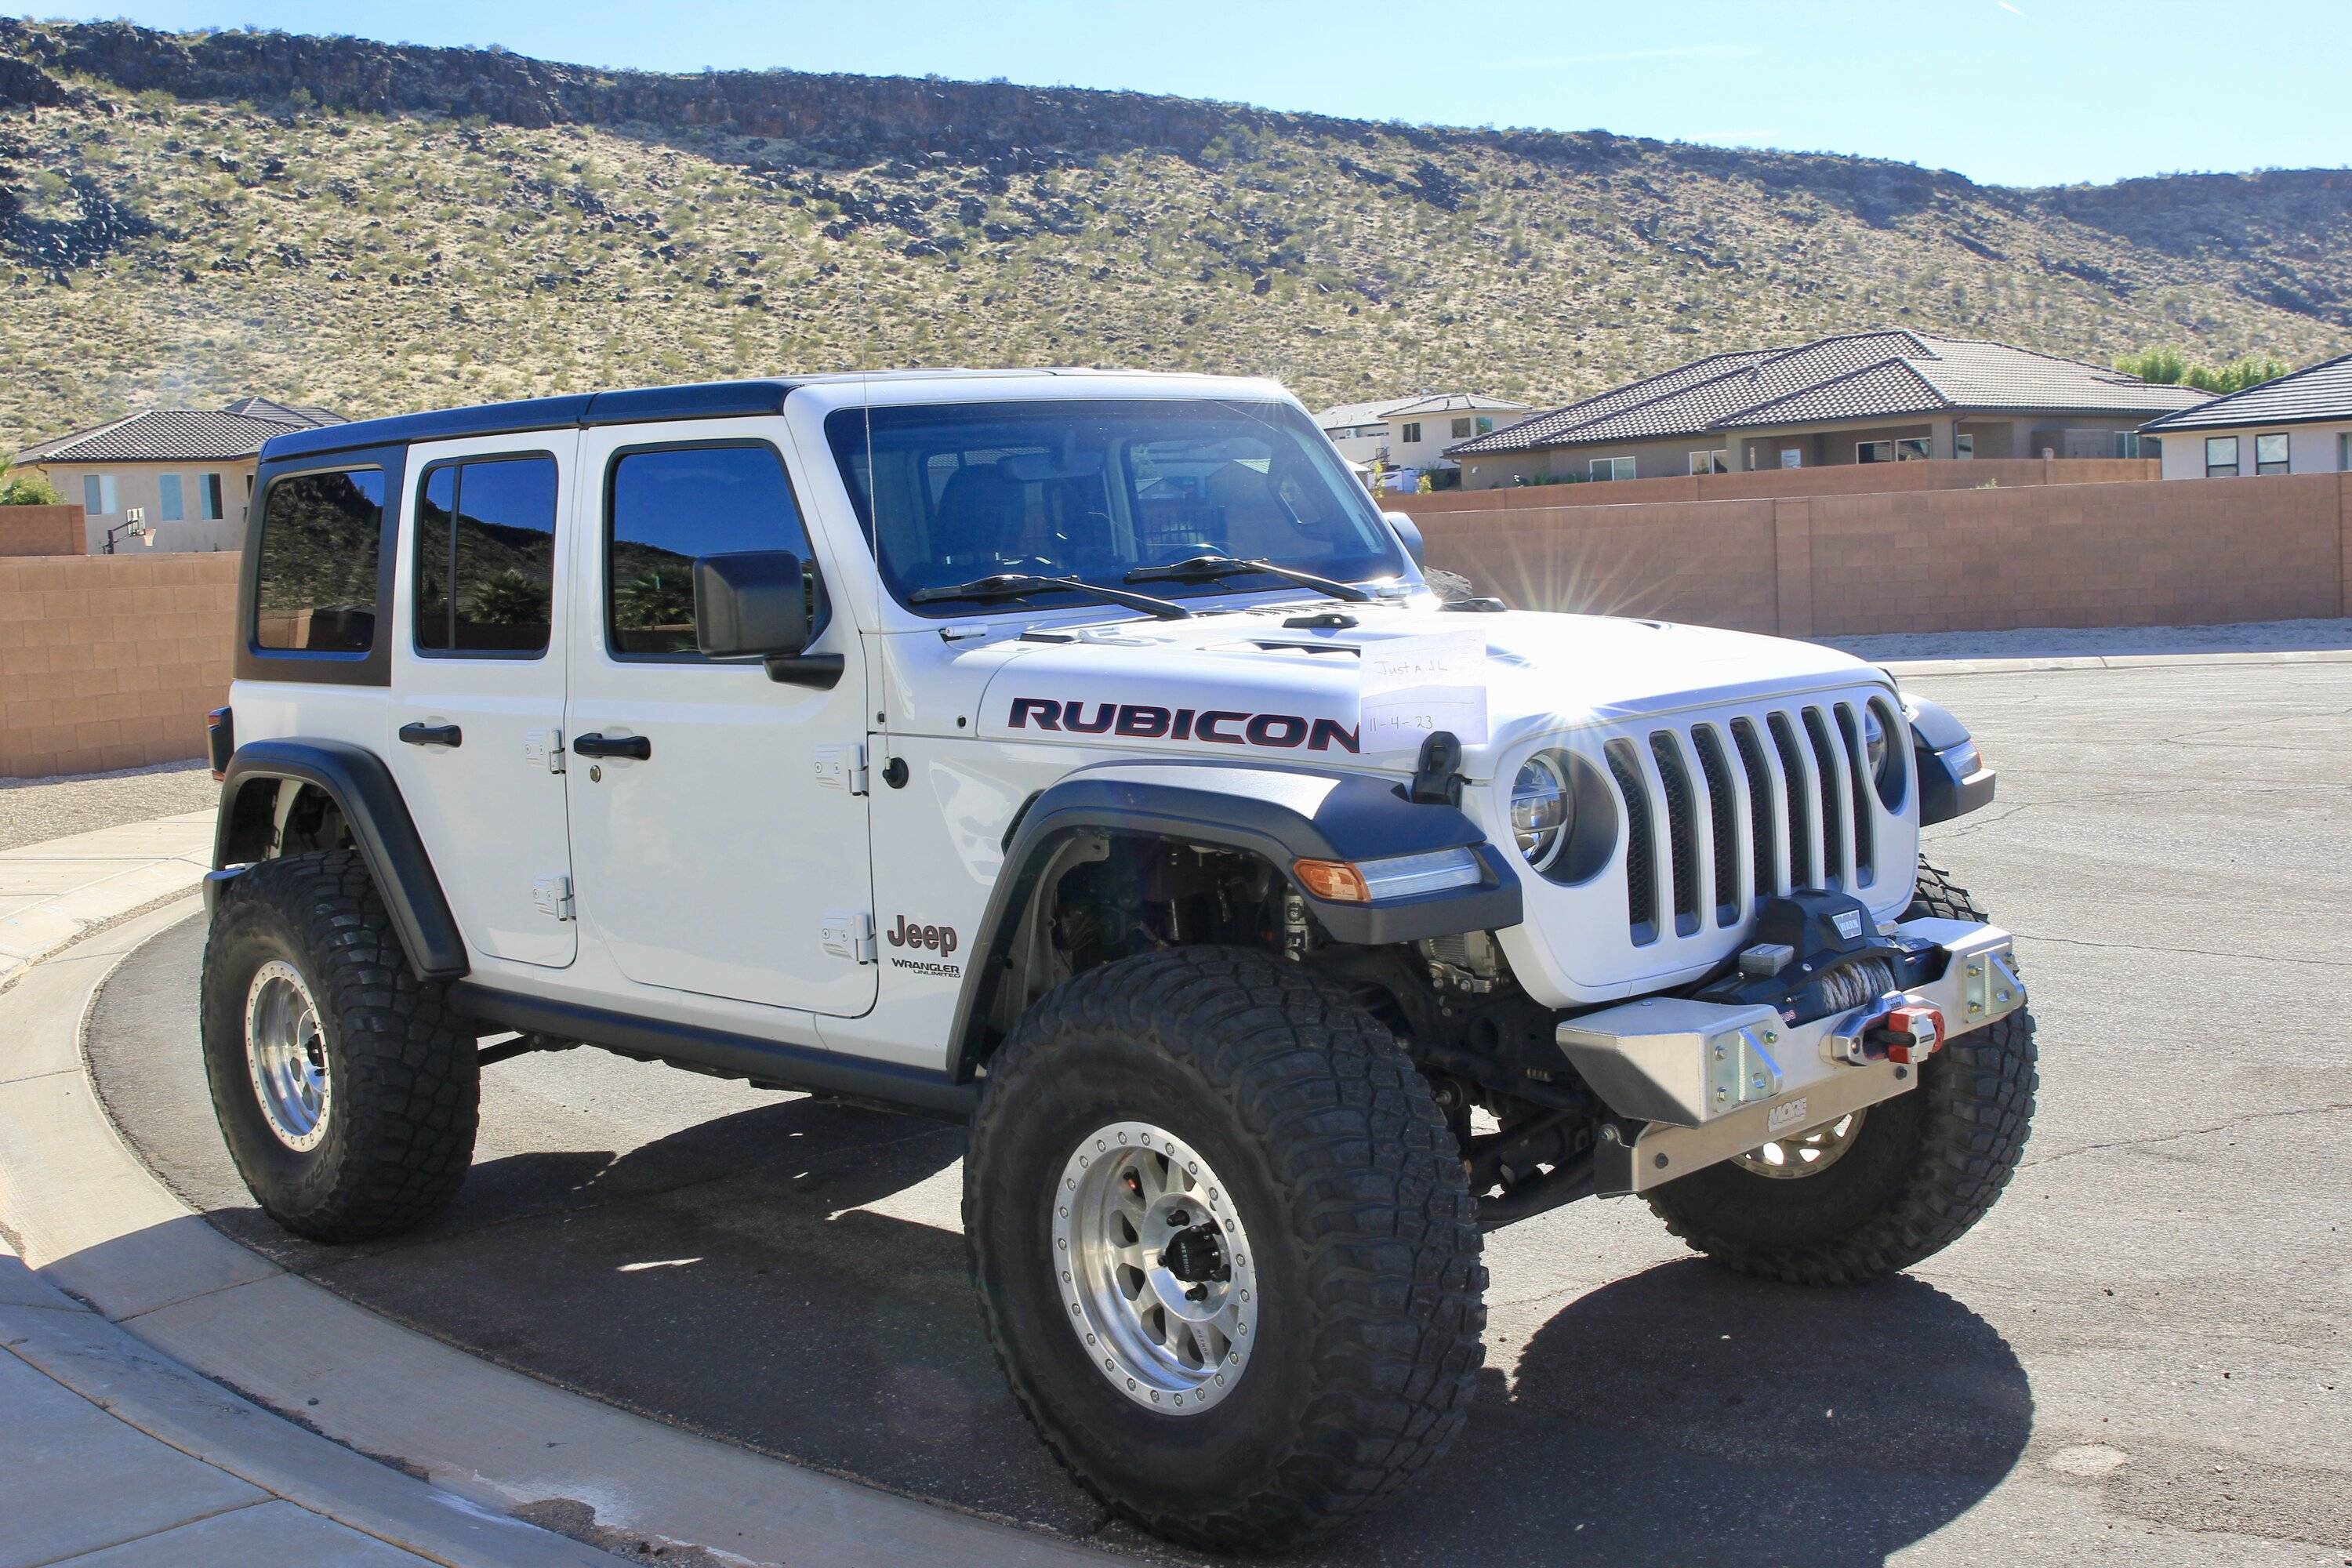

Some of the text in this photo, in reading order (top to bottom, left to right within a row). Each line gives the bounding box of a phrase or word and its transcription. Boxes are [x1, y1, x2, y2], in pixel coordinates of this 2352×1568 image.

[1374, 660, 1410, 676] Just
[1007, 696, 1360, 754] RUBICON
[887, 914, 957, 958] Jeep
[1838, 919, 1859, 932] WARN
[891, 957, 960, 973] WRANGLER
[913, 969, 960, 978] UNLIMITED
[1768, 1097, 1807, 1127] MORE
[1180, 1242, 1191, 1275] METHOD
